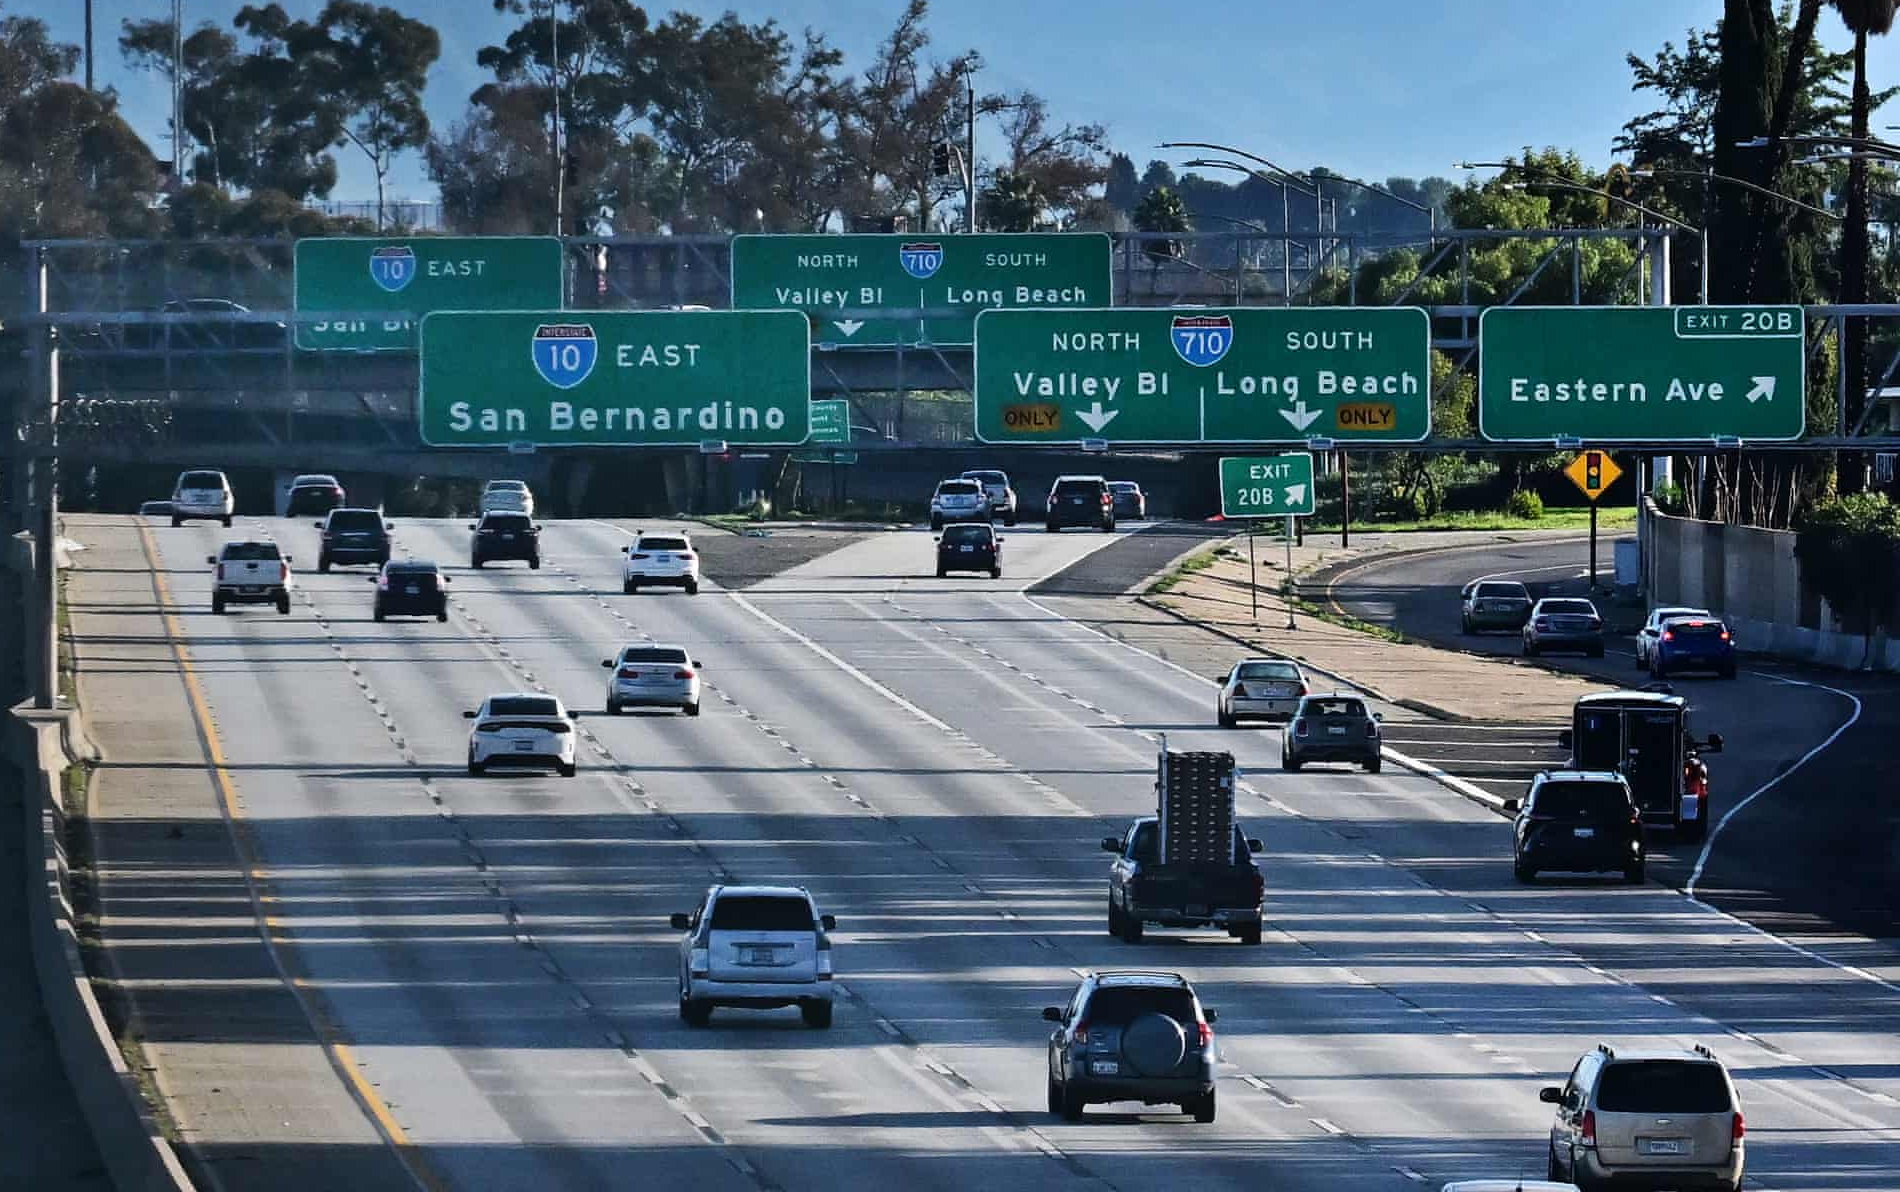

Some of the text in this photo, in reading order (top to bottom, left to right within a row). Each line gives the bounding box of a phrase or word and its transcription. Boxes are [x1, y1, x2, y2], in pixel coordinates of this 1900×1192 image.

[383, 260, 486, 280] 10 EAST
[797, 253, 1046, 271] NORTH 710 SOUTH
[775, 287, 882, 308] Valley Bl
[947, 286, 1086, 307] Long Beach
[1686, 311, 1792, 331] EXIT 20B
[1052, 331, 1373, 355] NORTH 710 SOUTH
[550, 343, 701, 371] 10 EAST
[1013, 372, 1169, 401] Valley Bl
[1217, 370, 1418, 402] Long Beach
[1511, 378, 1724, 402] Eastern Ave
[449, 400, 785, 432] San Bernardino
[1004, 410, 1058, 426] ONLY
[1339, 408, 1392, 425] ONLY
[1250, 464, 1291, 480] EXIT
[1238, 488, 1274, 506] 20B
